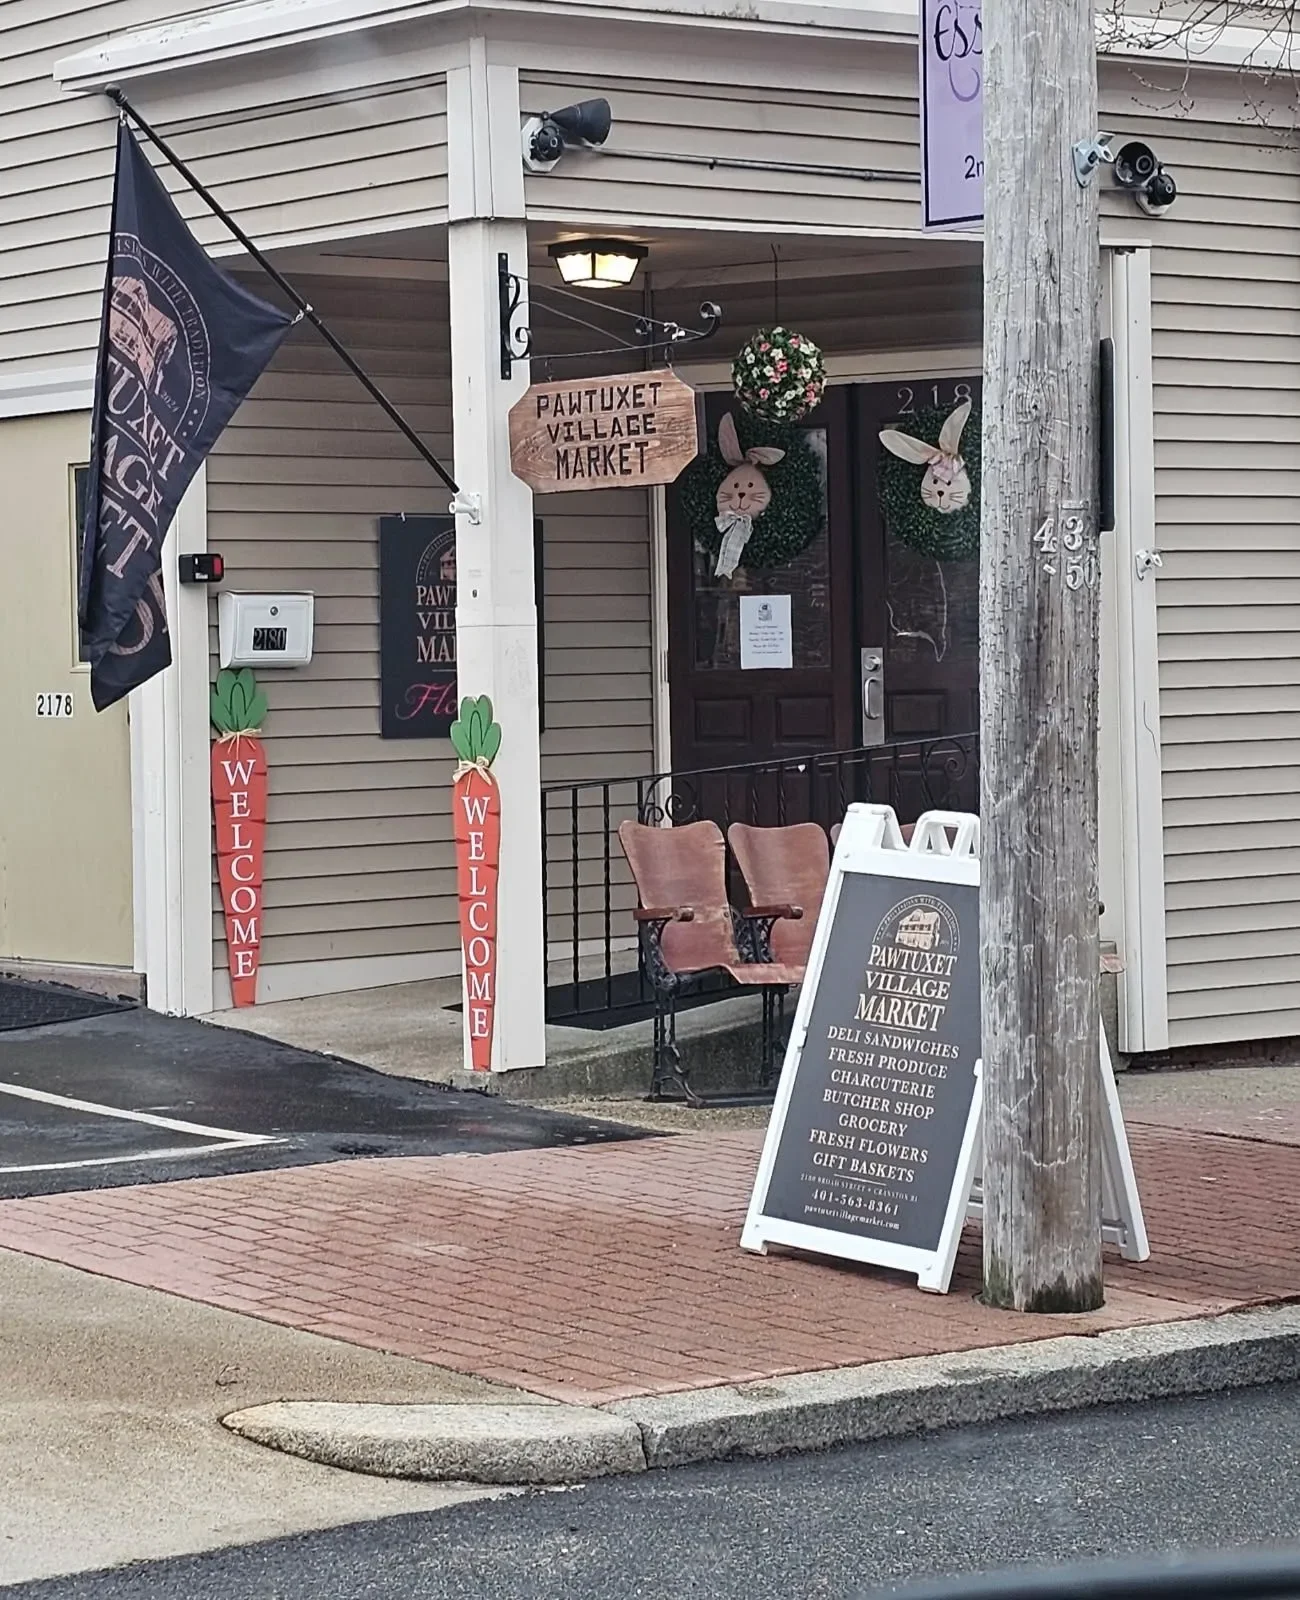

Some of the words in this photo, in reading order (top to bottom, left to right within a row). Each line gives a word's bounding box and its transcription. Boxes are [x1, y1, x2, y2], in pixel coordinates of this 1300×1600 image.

[182, 305, 206, 400] TRADITION
[160, 391, 181, 414] 2024
[537, 382, 662, 419] PAWTUXET
[547, 413, 656, 444] VILLAGE
[556, 441, 649, 480] MARKET
[253, 628, 286, 651] 2180
[37, 694, 73, 716] 2178
[221, 759, 259, 978] WELCOME
[461, 796, 492, 1037] WELCOME
[868, 945, 957, 976] PAWTUXET
[865, 971, 951, 1000] VILLAGE
[854, 994, 945, 1031] MARKET
[827, 1026, 861, 1043] DELI
[864, 1031, 960, 1059] SANDWICHES
[828, 1047, 875, 1067] FRESH
[878, 1055, 948, 1079] PRODUCE
[831, 1069, 936, 1099] CHARCUTERIE
[823, 1089, 890, 1113] BUTCHER
[894, 1101, 934, 1120] SHOP
[839, 1113, 908, 1137] GROCERY
[809, 1129, 856, 1150] FRESH
[859, 1138, 928, 1163] FLOWERS
[813, 1152, 847, 1170] GIFT
[850, 1158, 915, 1183] BASKETS
[841, 1180, 866, 1192] STREET
[812, 1188, 899, 1216] 401-563-8361
